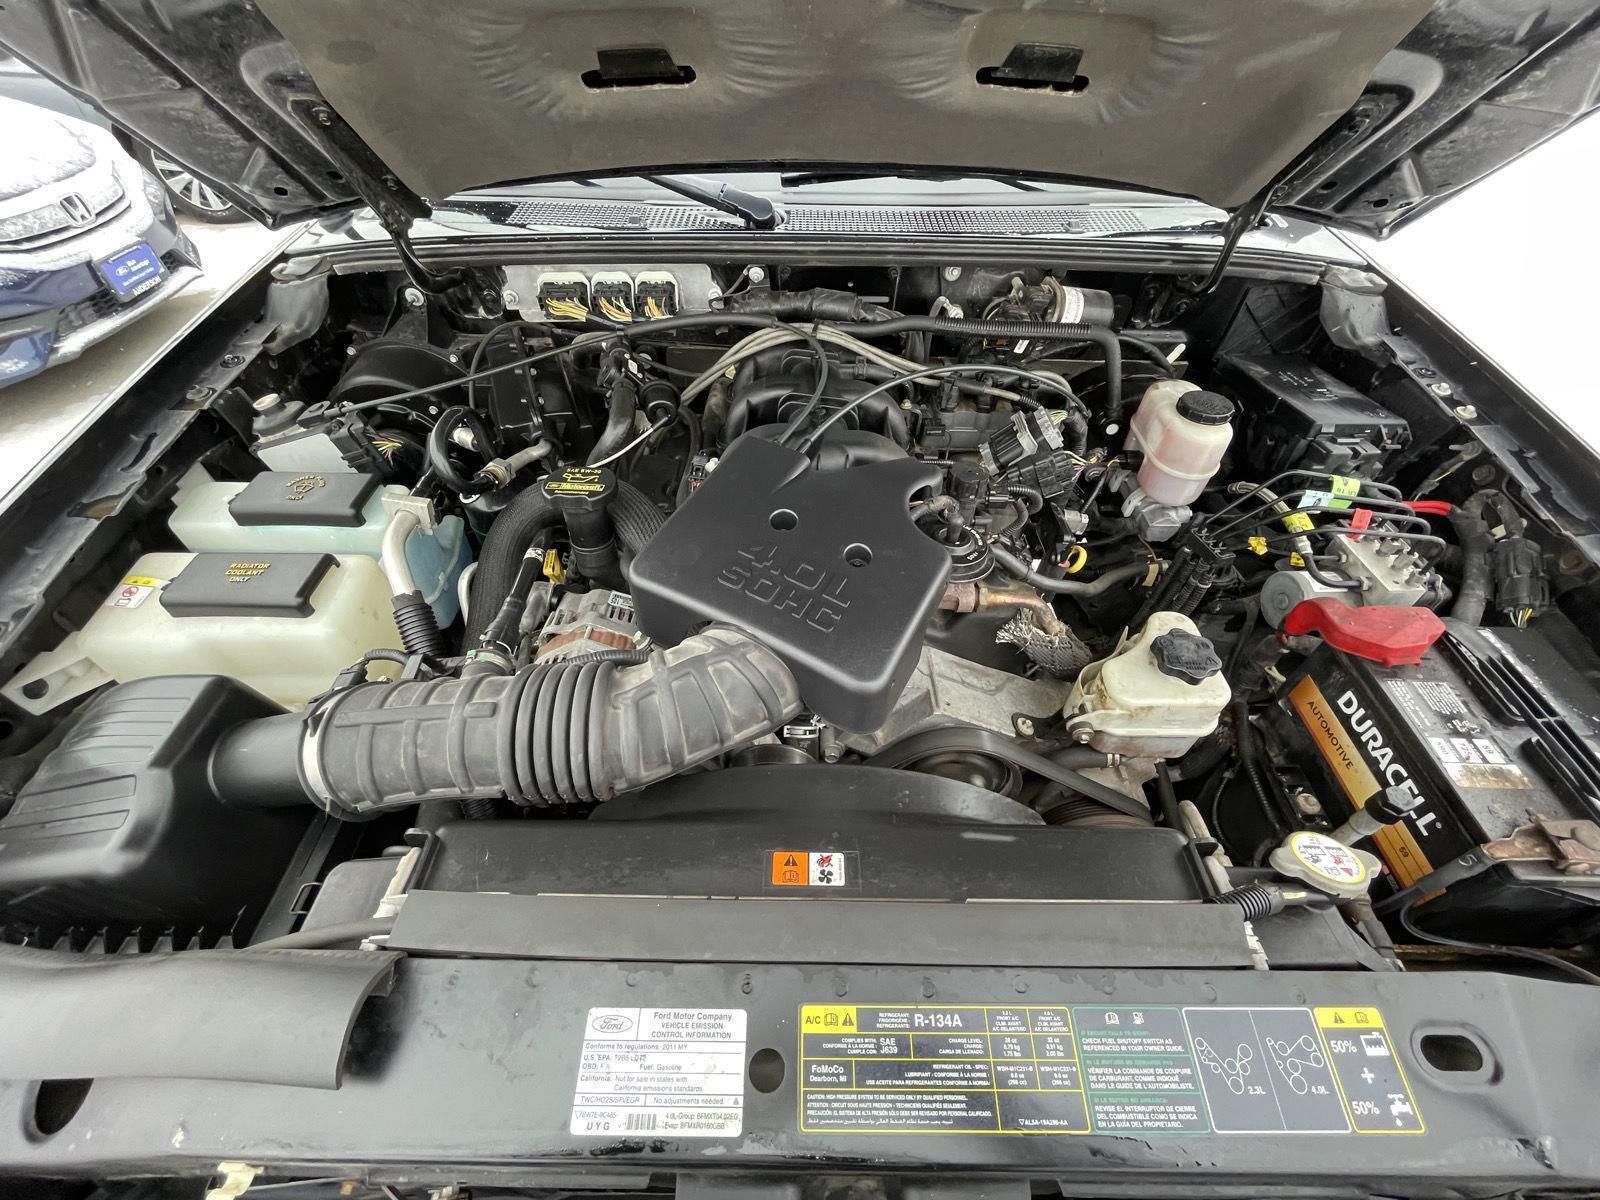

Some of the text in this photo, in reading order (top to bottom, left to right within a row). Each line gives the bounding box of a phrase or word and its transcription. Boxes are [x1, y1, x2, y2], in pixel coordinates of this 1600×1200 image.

[132, 276, 162, 296] ANDERSON
[717, 566, 842, 633] SOHC
[1307, 701, 1354, 770] AUTOMOTIVE
[600, 1017, 624, 1030] Ford
[697, 1013, 732, 1021] Company
[806, 1016, 820, 1024] A/C
[914, 1014, 962, 1027] R-134A
[1330, 1040, 1357, 1053] 50%
[812, 1065, 844, 1074] FoMoCo
[1248, 1086, 1266, 1094] 2.3L
[1312, 1086, 1329, 1094] 4.0L
[1352, 1101, 1380, 1115] 50%
